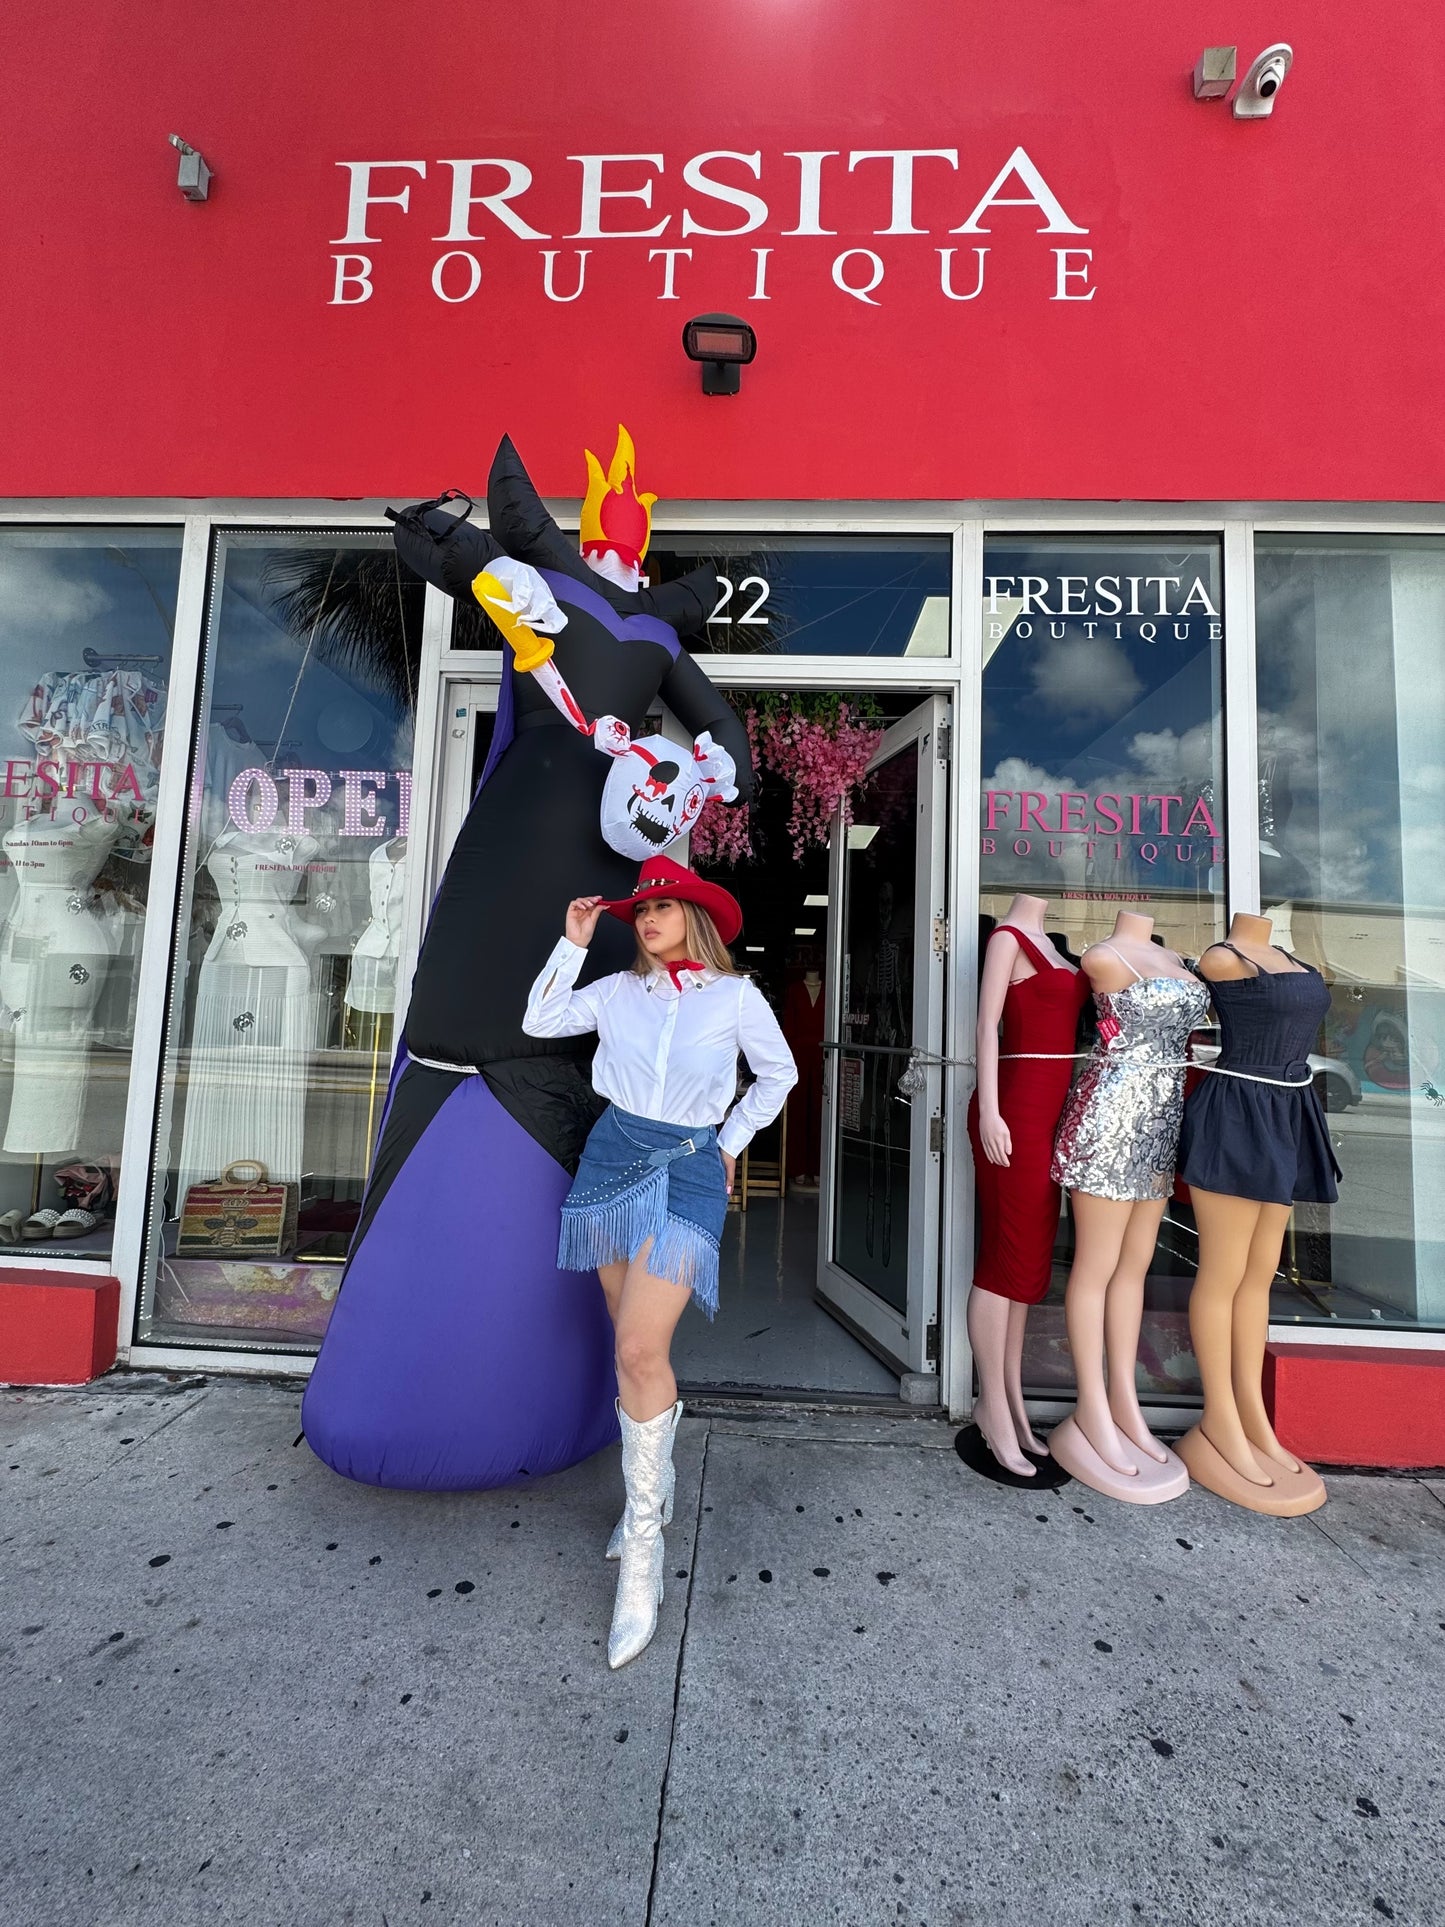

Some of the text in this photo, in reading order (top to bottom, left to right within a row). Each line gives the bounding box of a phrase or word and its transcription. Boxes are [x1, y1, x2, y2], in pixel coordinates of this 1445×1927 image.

[329, 146, 1089, 244] FRESITA
[327, 248, 1097, 306] BOUTIQUE
[985, 576, 1220, 616] FRESITA
[989, 622, 1223, 643] BOUTIQUE
[982, 790, 1221, 837] FRESITA
[58, 840, 73, 848] 6pm
[981, 838, 1226, 864] BOUTIQUE
[30, 861, 45, 869] 3pm
